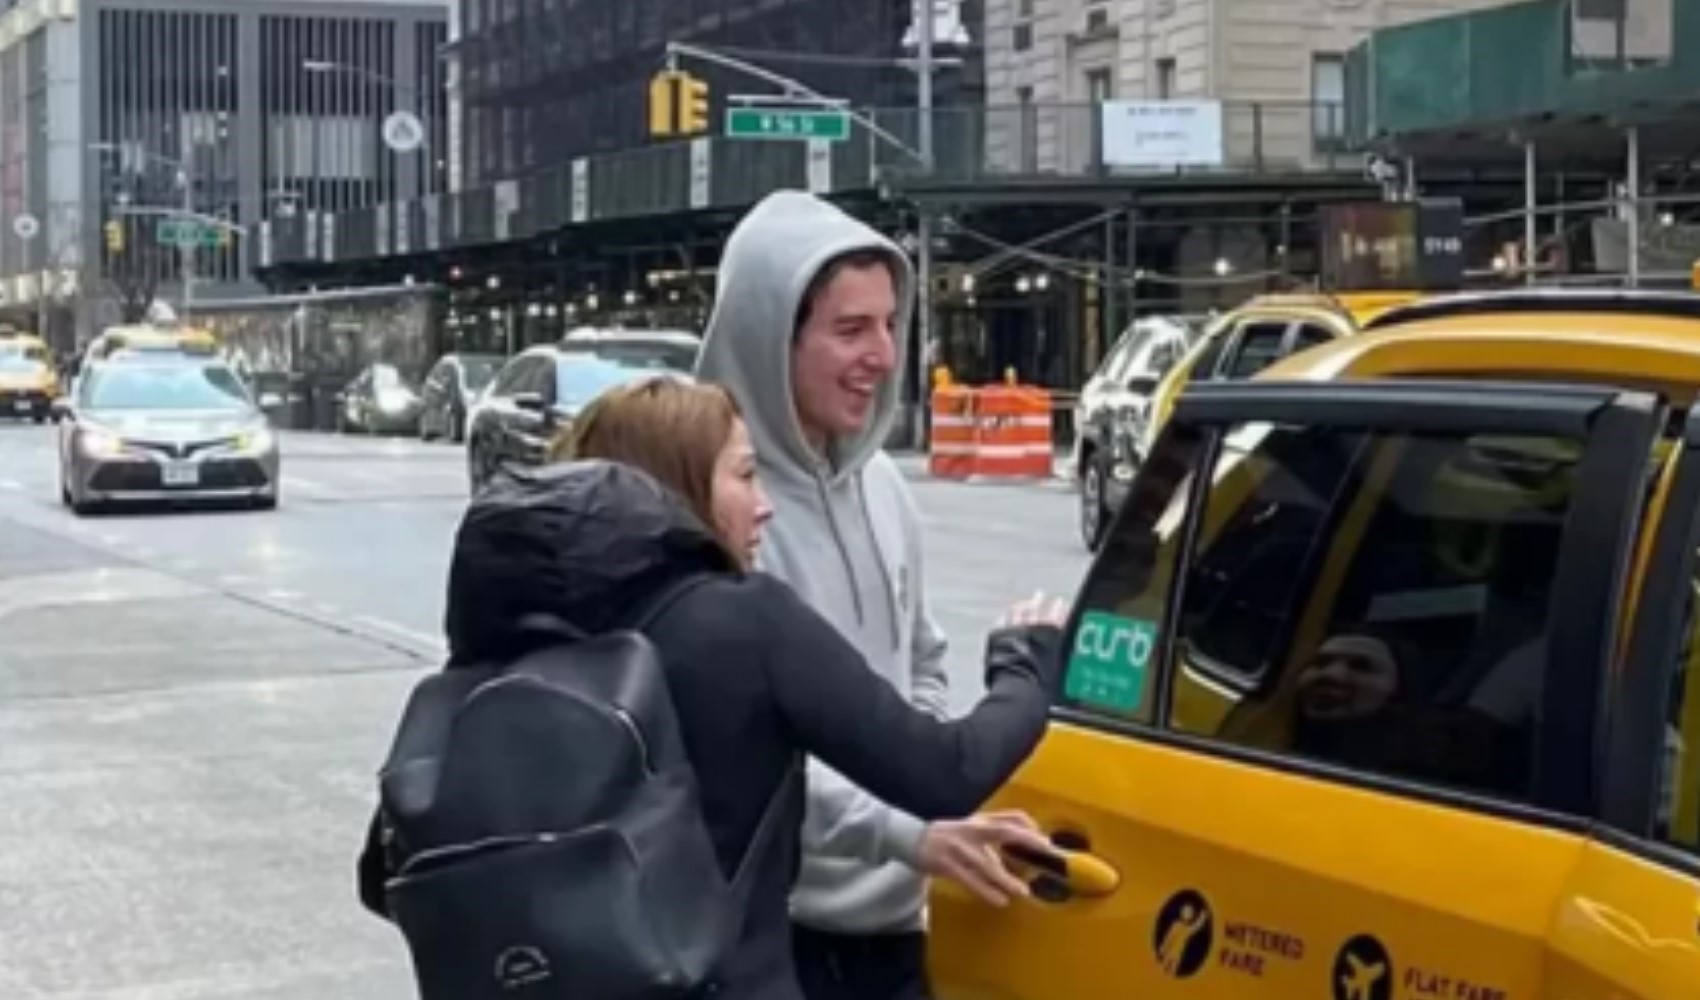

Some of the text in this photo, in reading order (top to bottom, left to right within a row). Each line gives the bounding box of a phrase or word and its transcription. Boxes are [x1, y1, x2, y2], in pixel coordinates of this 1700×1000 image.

[1075, 621, 1151, 667] curb
[1224, 920, 1304, 961] METERED
[1220, 946, 1264, 976] FARE
[1403, 965, 1450, 996] FLAT
